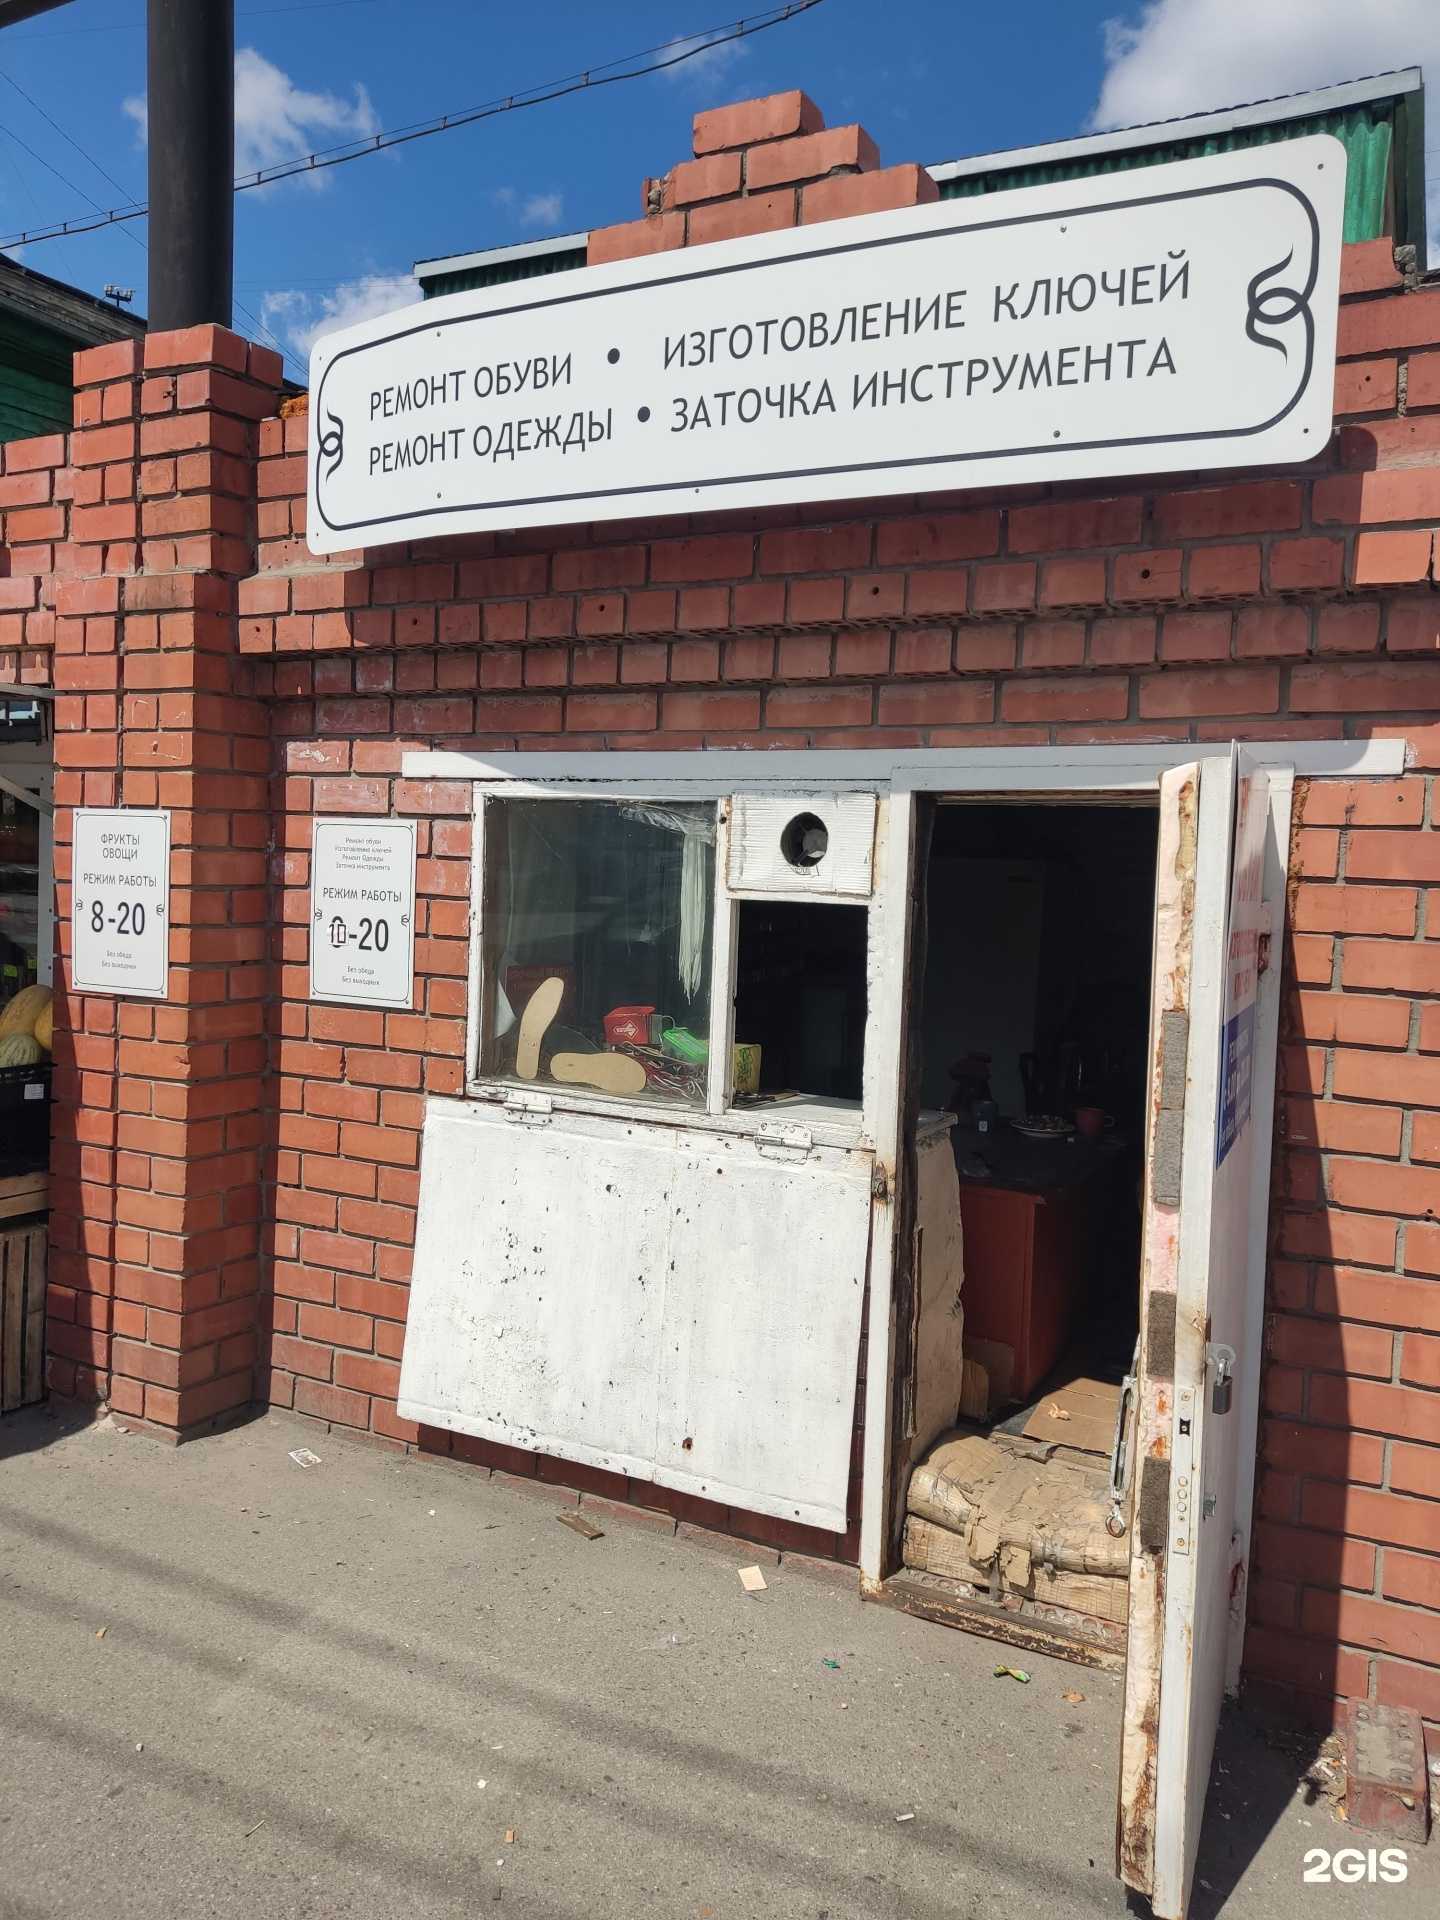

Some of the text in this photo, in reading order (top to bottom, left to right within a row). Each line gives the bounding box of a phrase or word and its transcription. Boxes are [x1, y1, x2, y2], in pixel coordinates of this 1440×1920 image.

[369, 248, 1190, 421] РЕМОНТ ОБУВИ ИЗГОТОВЛЕНИЕ КЛЮЧЕЙ
[369, 337, 1177, 476] РЕМОНТ ОДЕЖДЫ ЗАТОЧКА ИНСТРУМЕНТА
[100, 833, 140, 846] ФРУКТЫ
[102, 847, 138, 862] ОВОЩИ
[83, 873, 157, 888] РЕЖИМ РАБОТЫ
[322, 887, 402, 902] РЕЖИМ РАБОТЫ
[91, 899, 146, 936] 8-20
